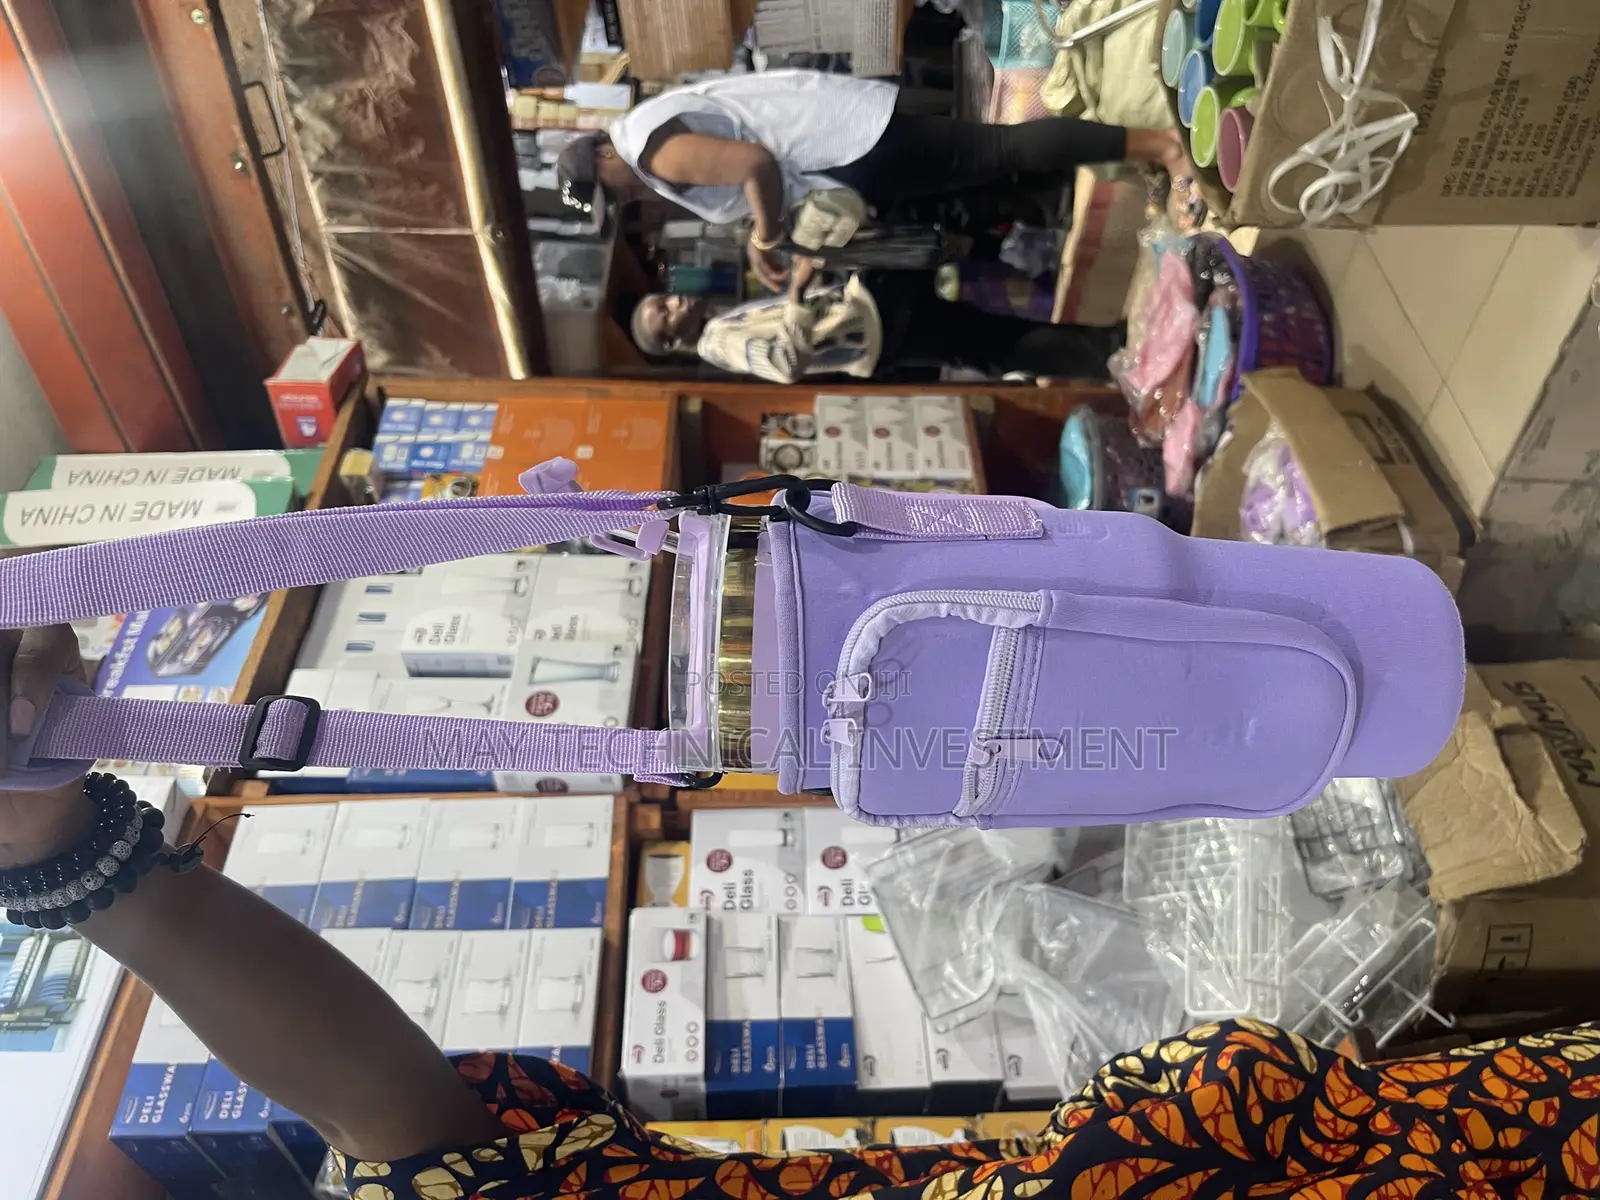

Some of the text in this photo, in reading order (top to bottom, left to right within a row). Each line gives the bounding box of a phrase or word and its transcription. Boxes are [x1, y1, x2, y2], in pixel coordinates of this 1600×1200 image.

[1479, 88, 1503, 128] COLOR
[67, 466, 241, 488] MADE IN CHINA
[20, 498, 203, 528] MADE IN CHINA
[722, 882, 737, 911] Deli
[740, 869, 755, 911] Glass
[840, 878, 854, 906] Deli
[652, 1000, 667, 1064] Deli Glass
[139, 1095, 155, 1124] DELI
[219, 1090, 234, 1120] DELI
